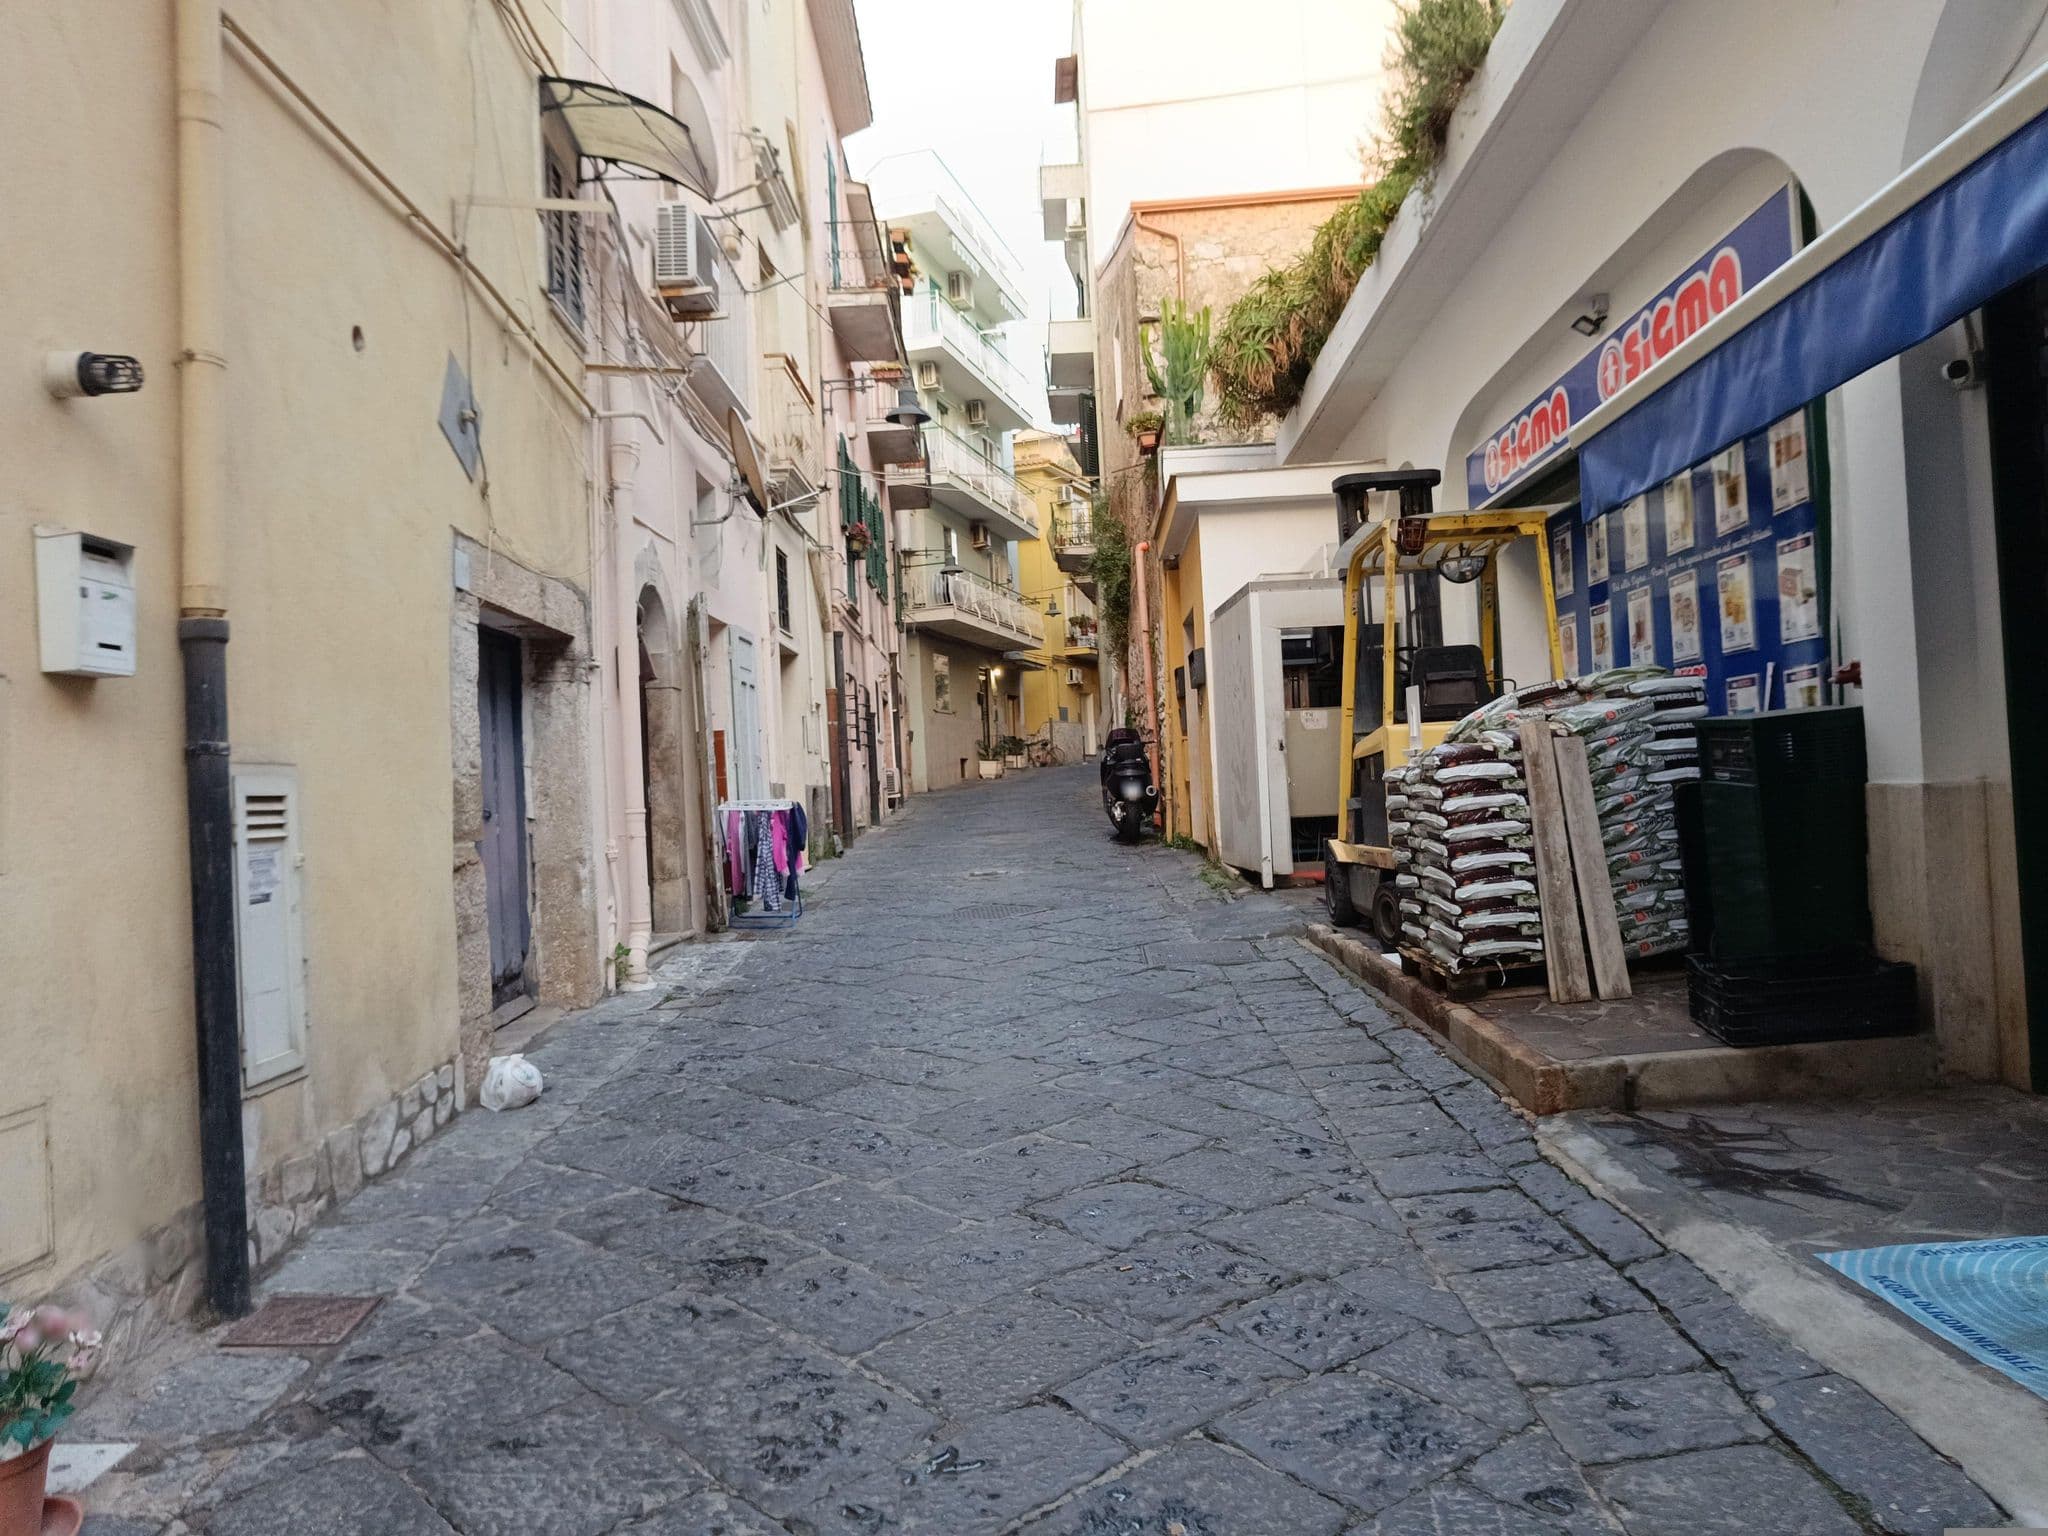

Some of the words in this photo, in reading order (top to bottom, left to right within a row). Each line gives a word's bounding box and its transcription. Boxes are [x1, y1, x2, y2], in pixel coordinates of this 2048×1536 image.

[1499, 389, 1569, 478] SIGMA
[1617, 697, 1654, 716] TERRICCIO
[1654, 722, 1695, 733] UNIVERSAL
[1868, 1274, 1921, 1300] ACQUA
[1913, 1300, 2045, 1373] OLIGOMINERALE
